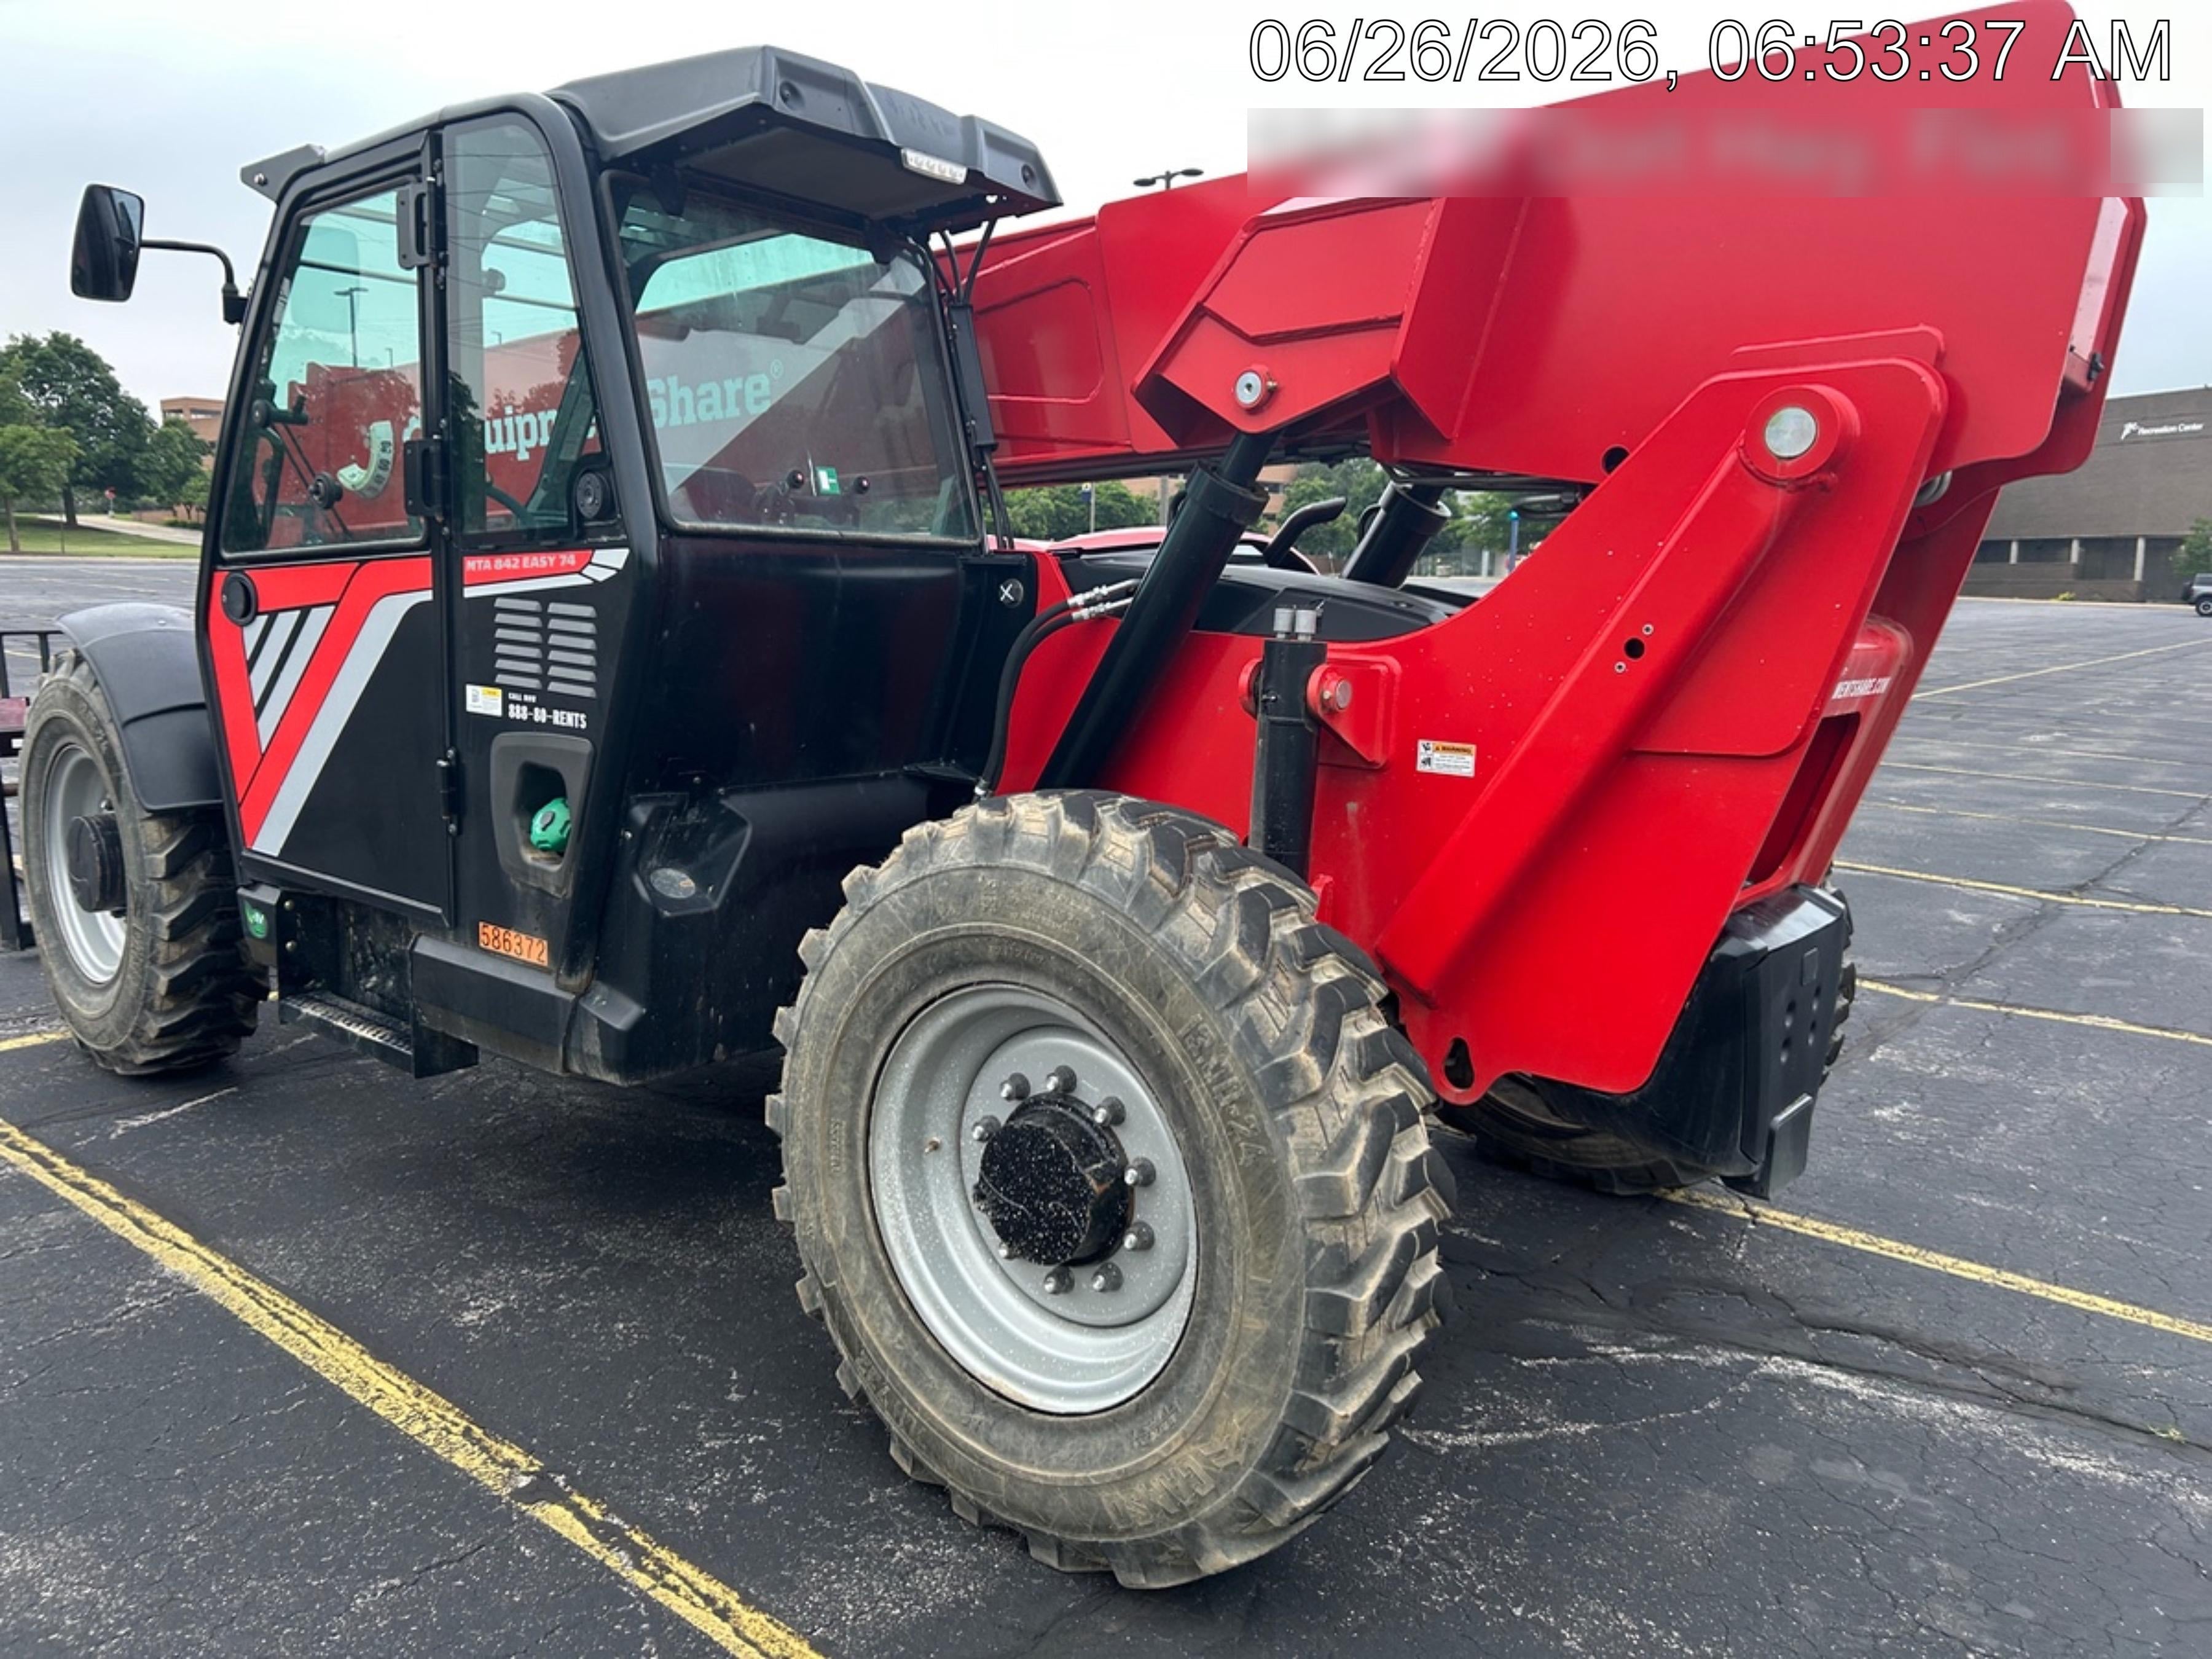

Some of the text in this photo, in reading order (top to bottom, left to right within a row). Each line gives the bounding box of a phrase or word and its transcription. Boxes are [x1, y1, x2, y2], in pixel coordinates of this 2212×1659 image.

[2178, 423, 2204, 433] Center
[493, 557, 520, 570] 842
[523, 555, 555, 569] EASY
[559, 554, 576, 567] 74
[481, 924, 546, 963] 586372
